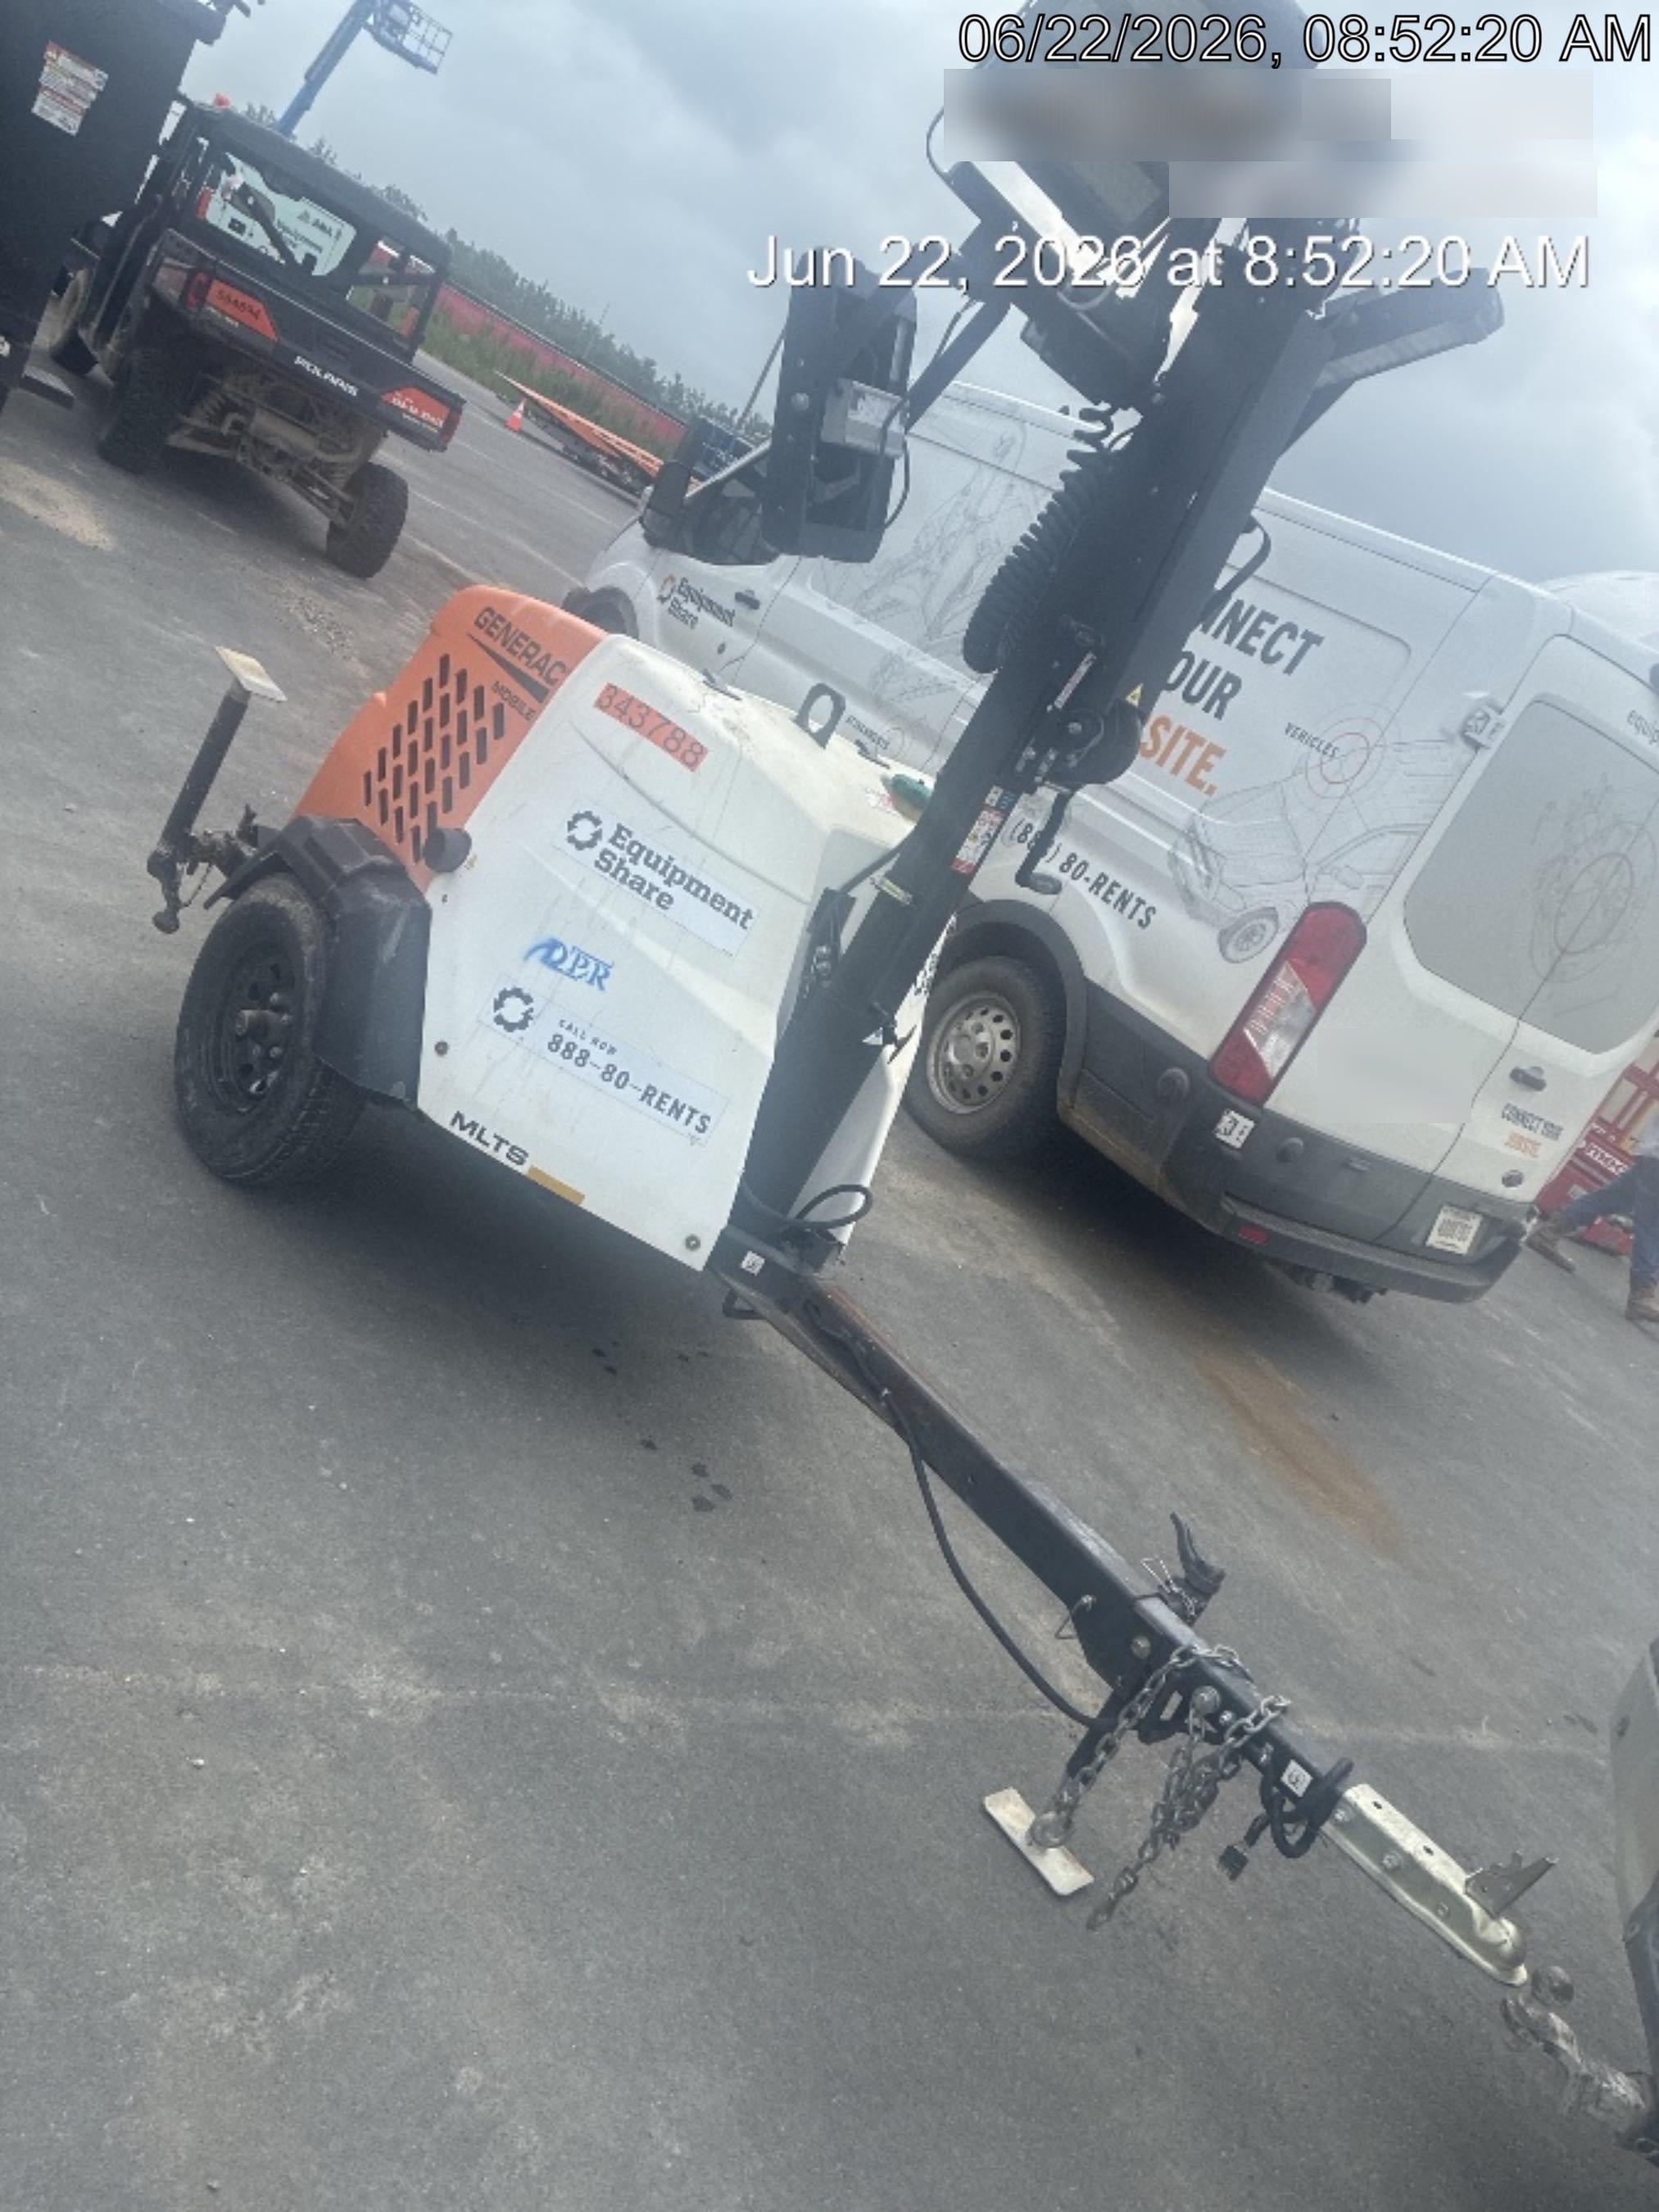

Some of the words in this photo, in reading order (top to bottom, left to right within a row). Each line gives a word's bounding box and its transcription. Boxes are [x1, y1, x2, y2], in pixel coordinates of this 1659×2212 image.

[474, 606, 567, 686] GENERAC
[1201, 599, 1325, 676] NECT
[493, 681, 537, 721] MOBILE
[1165, 651, 1242, 721] OUR
[1140, 715, 1227, 796] SITE.
[1285, 722, 1339, 758] VEHICLES
[594, 848, 673, 910] Share
[609, 823, 753, 930] Equipment
[1059, 853, 1156, 929] 80-RENTS
[559, 1019, 587, 1040] CALL
[591, 1037, 617, 1055] NOW
[547, 1034, 711, 1134] 888-80-RENTS
[451, 1111, 529, 1166] MLTS
